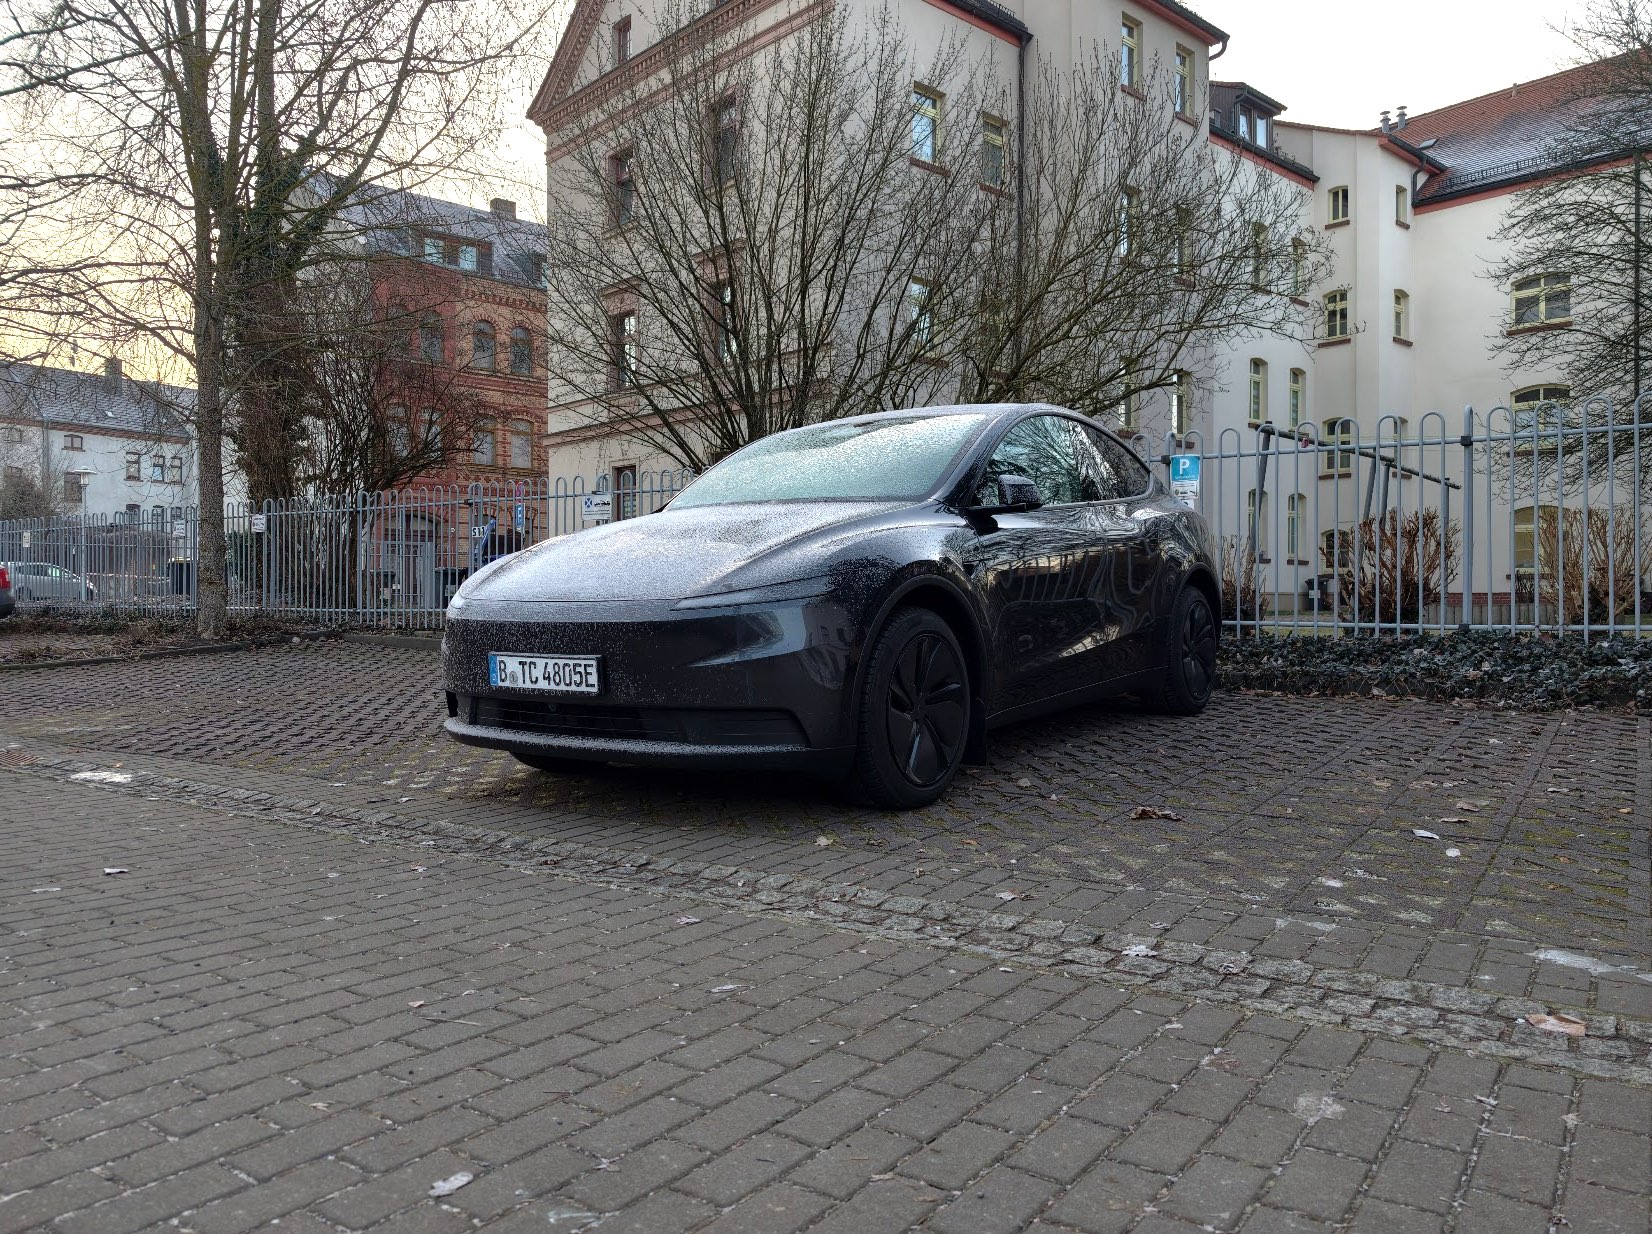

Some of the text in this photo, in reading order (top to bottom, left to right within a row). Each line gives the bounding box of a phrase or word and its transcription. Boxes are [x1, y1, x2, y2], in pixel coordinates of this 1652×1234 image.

[1180, 459, 1190, 475] P
[499, 660, 595, 688] B TC 4805E
